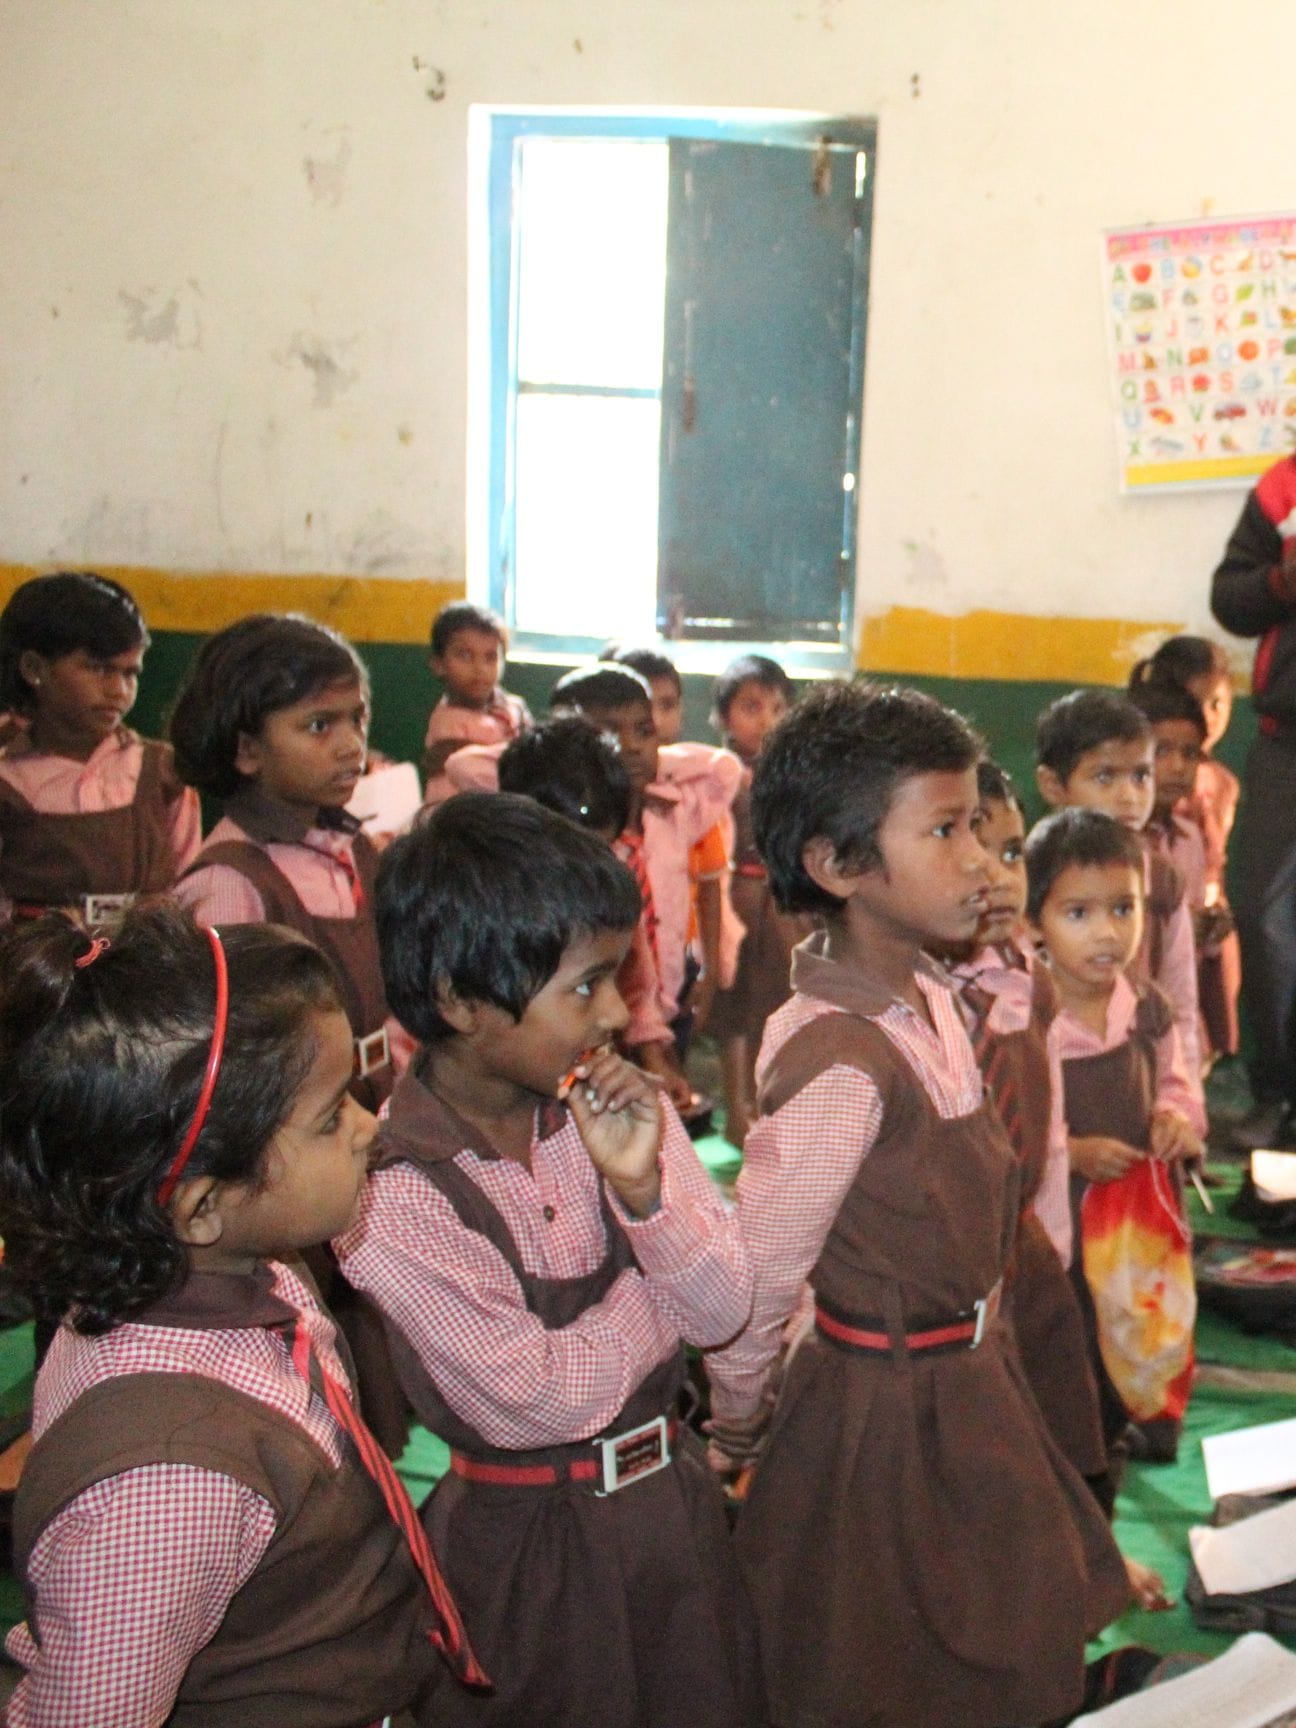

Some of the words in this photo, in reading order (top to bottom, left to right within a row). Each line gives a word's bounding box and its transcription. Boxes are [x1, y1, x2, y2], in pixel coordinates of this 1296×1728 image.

[1113, 263, 1126, 283] A
[1210, 254, 1225, 275] C
[1162, 289, 1175, 309] F
[1212, 283, 1227, 303] G
[1261, 280, 1276, 299] H
[1167, 318, 1178, 338] J
[1215, 314, 1229, 334] K
[1264, 310, 1278, 330] L
[1166, 347, 1184, 367] N
[1267, 338, 1281, 359] P
[1121, 379, 1138, 401] Q
[1219, 372, 1233, 393] S
[1124, 407, 1142, 429] U
[1189, 403, 1204, 422] V
[1257, 399, 1277, 417] W
[1192, 432, 1207, 452] Y
